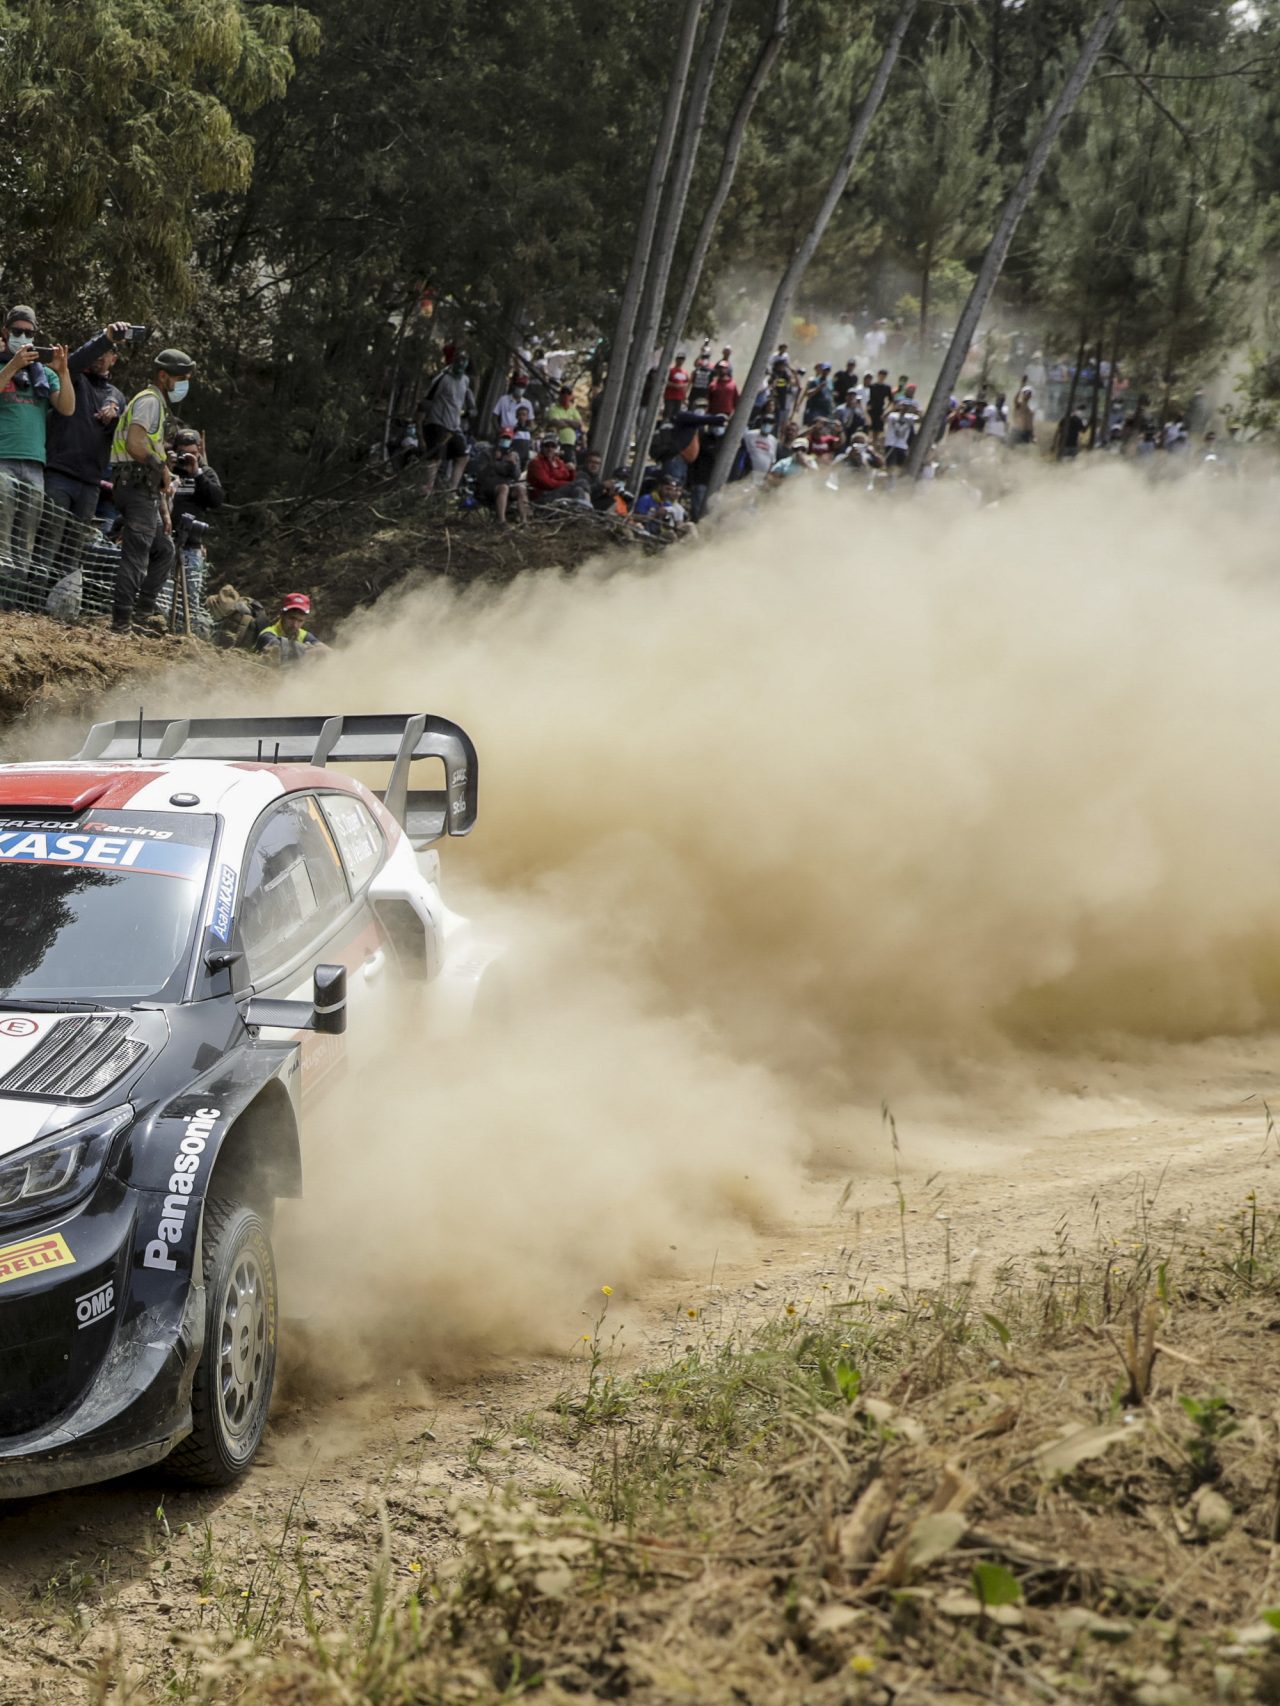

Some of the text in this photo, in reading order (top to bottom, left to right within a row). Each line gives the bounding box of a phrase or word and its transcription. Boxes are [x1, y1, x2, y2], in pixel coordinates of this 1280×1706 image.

[83, 821, 174, 840] Racing
[143, 1107, 221, 1271] Panasonic
[76, 1286, 114, 1323] OMP
